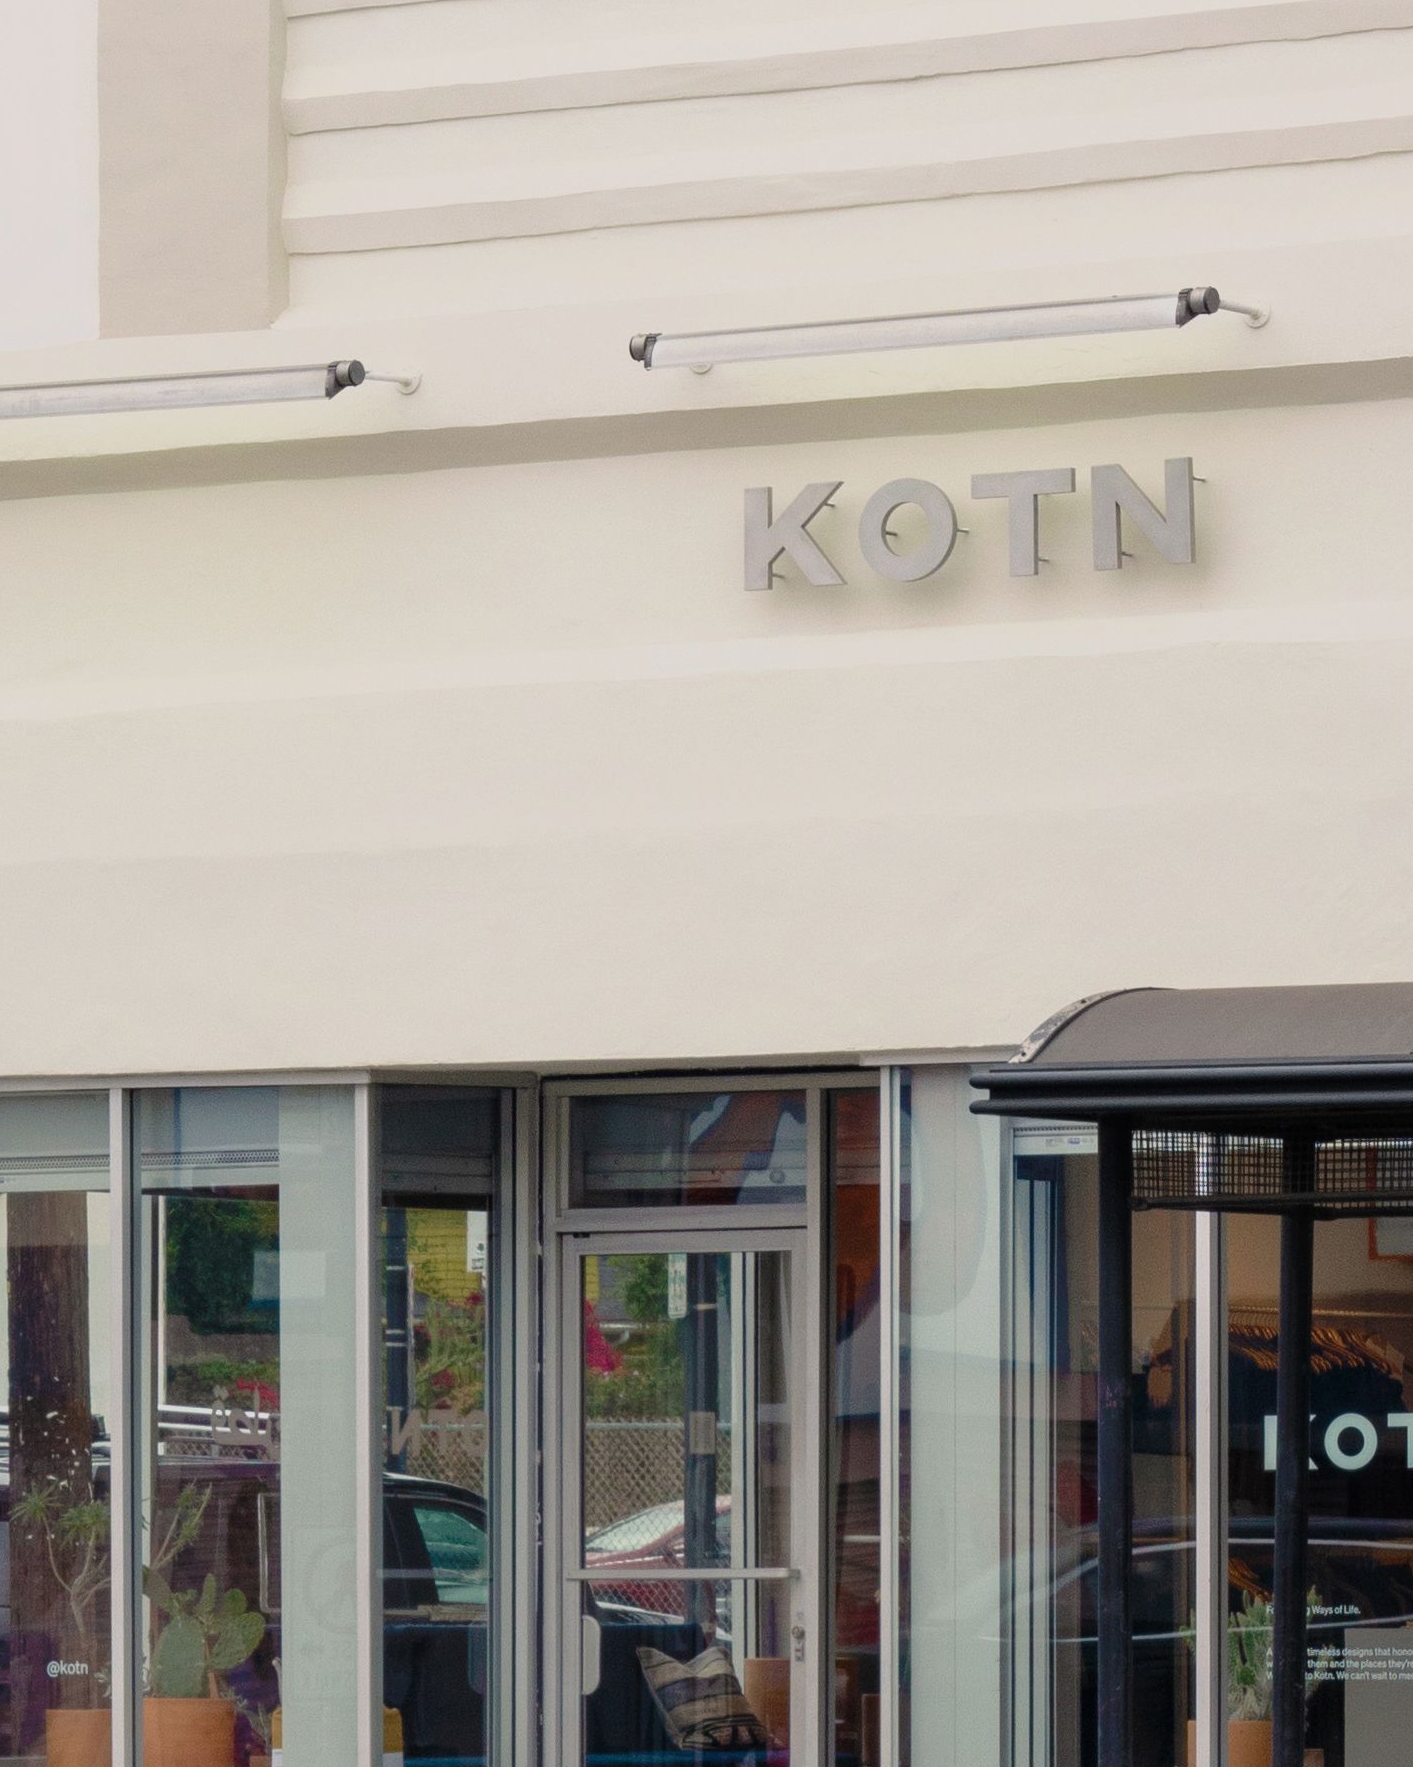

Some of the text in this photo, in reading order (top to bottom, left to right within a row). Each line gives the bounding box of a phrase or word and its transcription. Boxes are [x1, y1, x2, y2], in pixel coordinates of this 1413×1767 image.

[743, 456, 1196, 591] KOTN
[1311, 1605, 1334, 1617] Ways
[1334, 1605, 1343, 1614] of
[1344, 1605, 1361, 1614] Life.
[1307, 1646, 1341, 1657] timeless
[1341, 1646, 1374, 1659] designs
[1374, 1646, 1391, 1657] that
[46, 1660, 88, 1677] @kotn
[1307, 1658, 1329, 1669] them
[1329, 1658, 1344, 1669] and
[1345, 1658, 1359, 1669] the
[1360, 1659, 1388, 1671] places
[1313, 1670, 1334, 1680] Kotn.
[1336, 1670, 1350, 1680] We
[1370, 1670, 1388, 1680] wait
[1388, 1671, 1398, 1680] to
